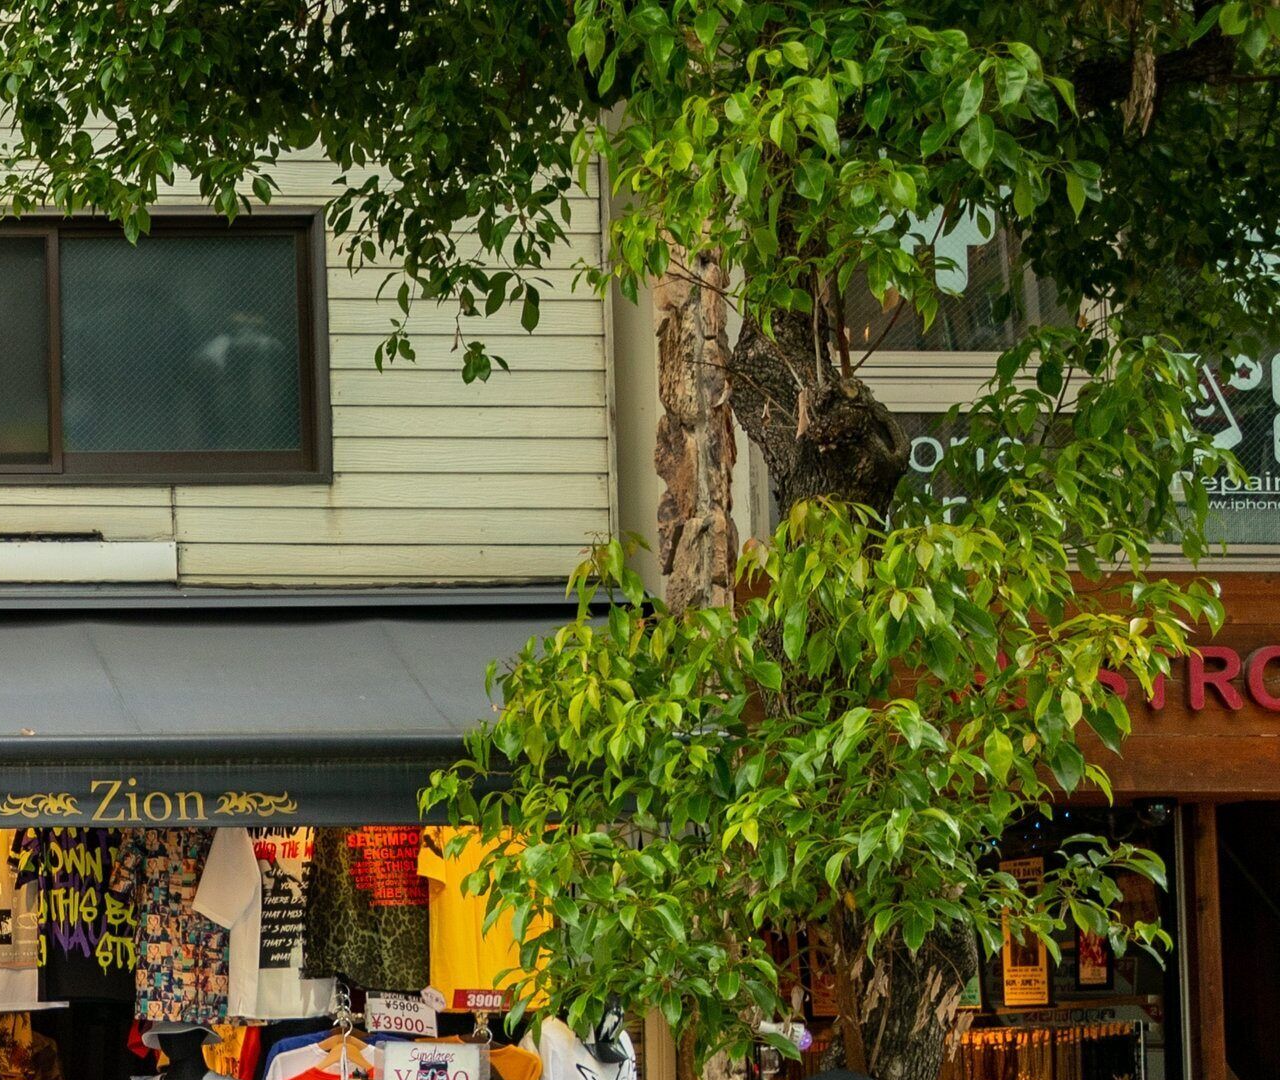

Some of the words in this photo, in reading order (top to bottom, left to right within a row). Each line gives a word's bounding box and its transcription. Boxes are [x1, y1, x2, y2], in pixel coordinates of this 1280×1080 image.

[90, 778, 208, 822] Zion
[347, 832, 420, 848] SELFIMPO
[262, 910, 281, 918] THAT
[386, 1000, 419, 1013] ¥5900
[467, 994, 502, 1007] 3900
